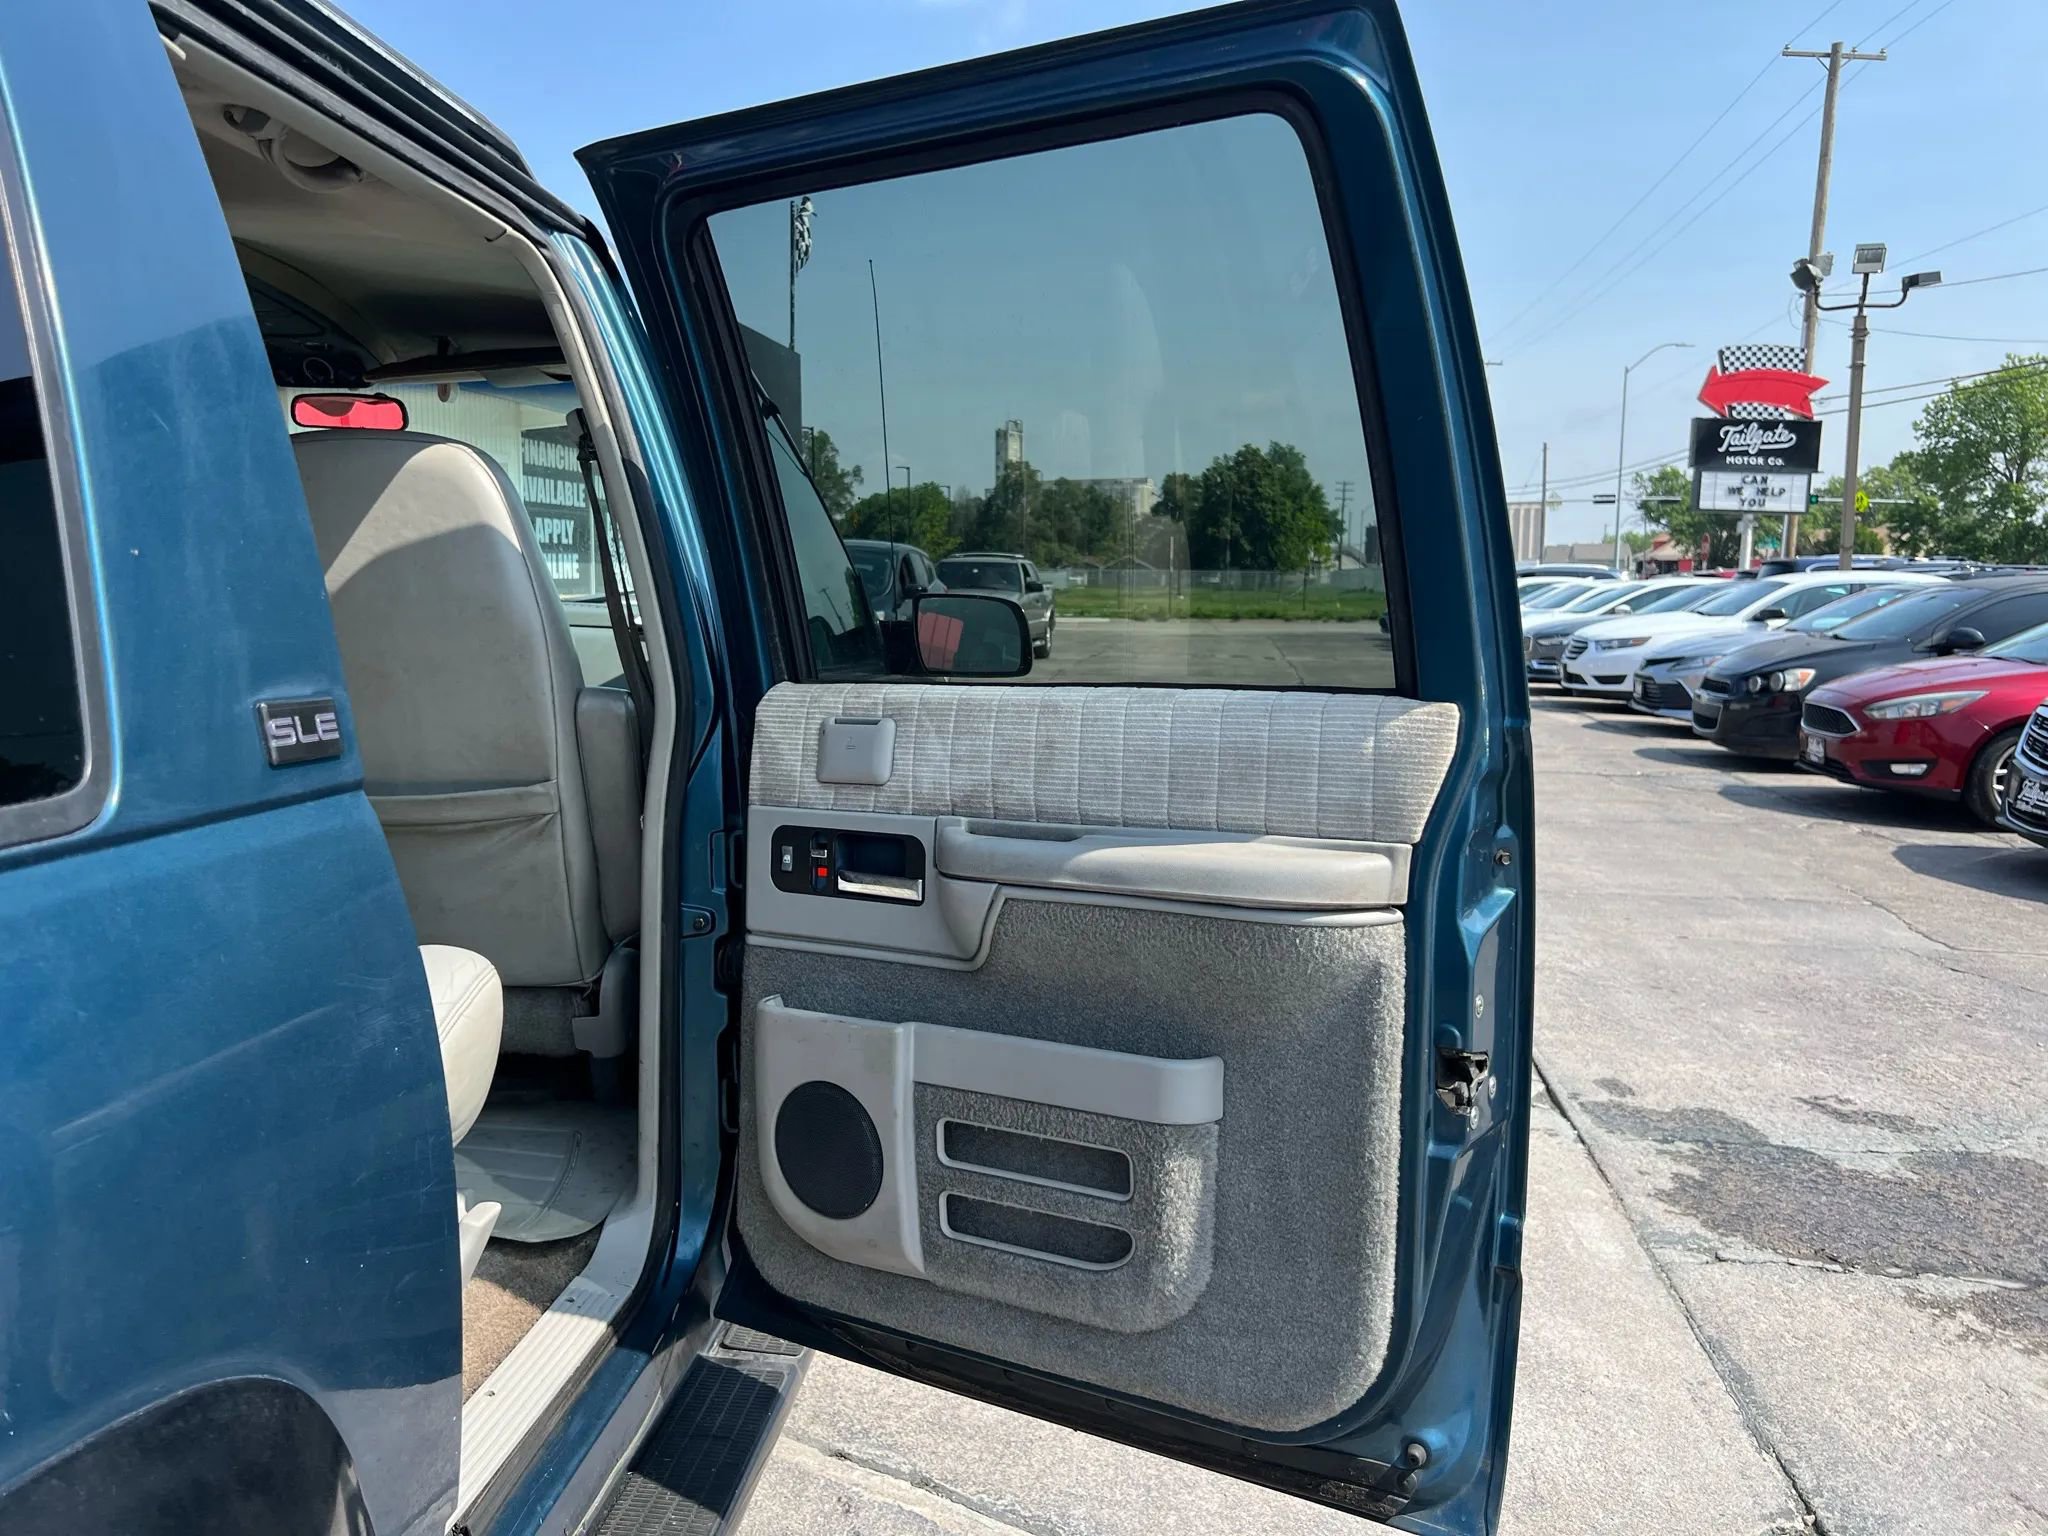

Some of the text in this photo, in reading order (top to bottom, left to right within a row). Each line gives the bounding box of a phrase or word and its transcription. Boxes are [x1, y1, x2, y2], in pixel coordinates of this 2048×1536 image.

[1717, 422, 1797, 454] Tailgate
[1726, 455, 1764, 466] MOTOR
[1742, 475, 1768, 484] CAN
[523, 475, 586, 508] AVAILABLE
[1728, 486, 1786, 497] WE HELP
[1740, 498, 1766, 508] YOU
[535, 517, 575, 545] APPLY
[266, 712, 340, 748] SLE
